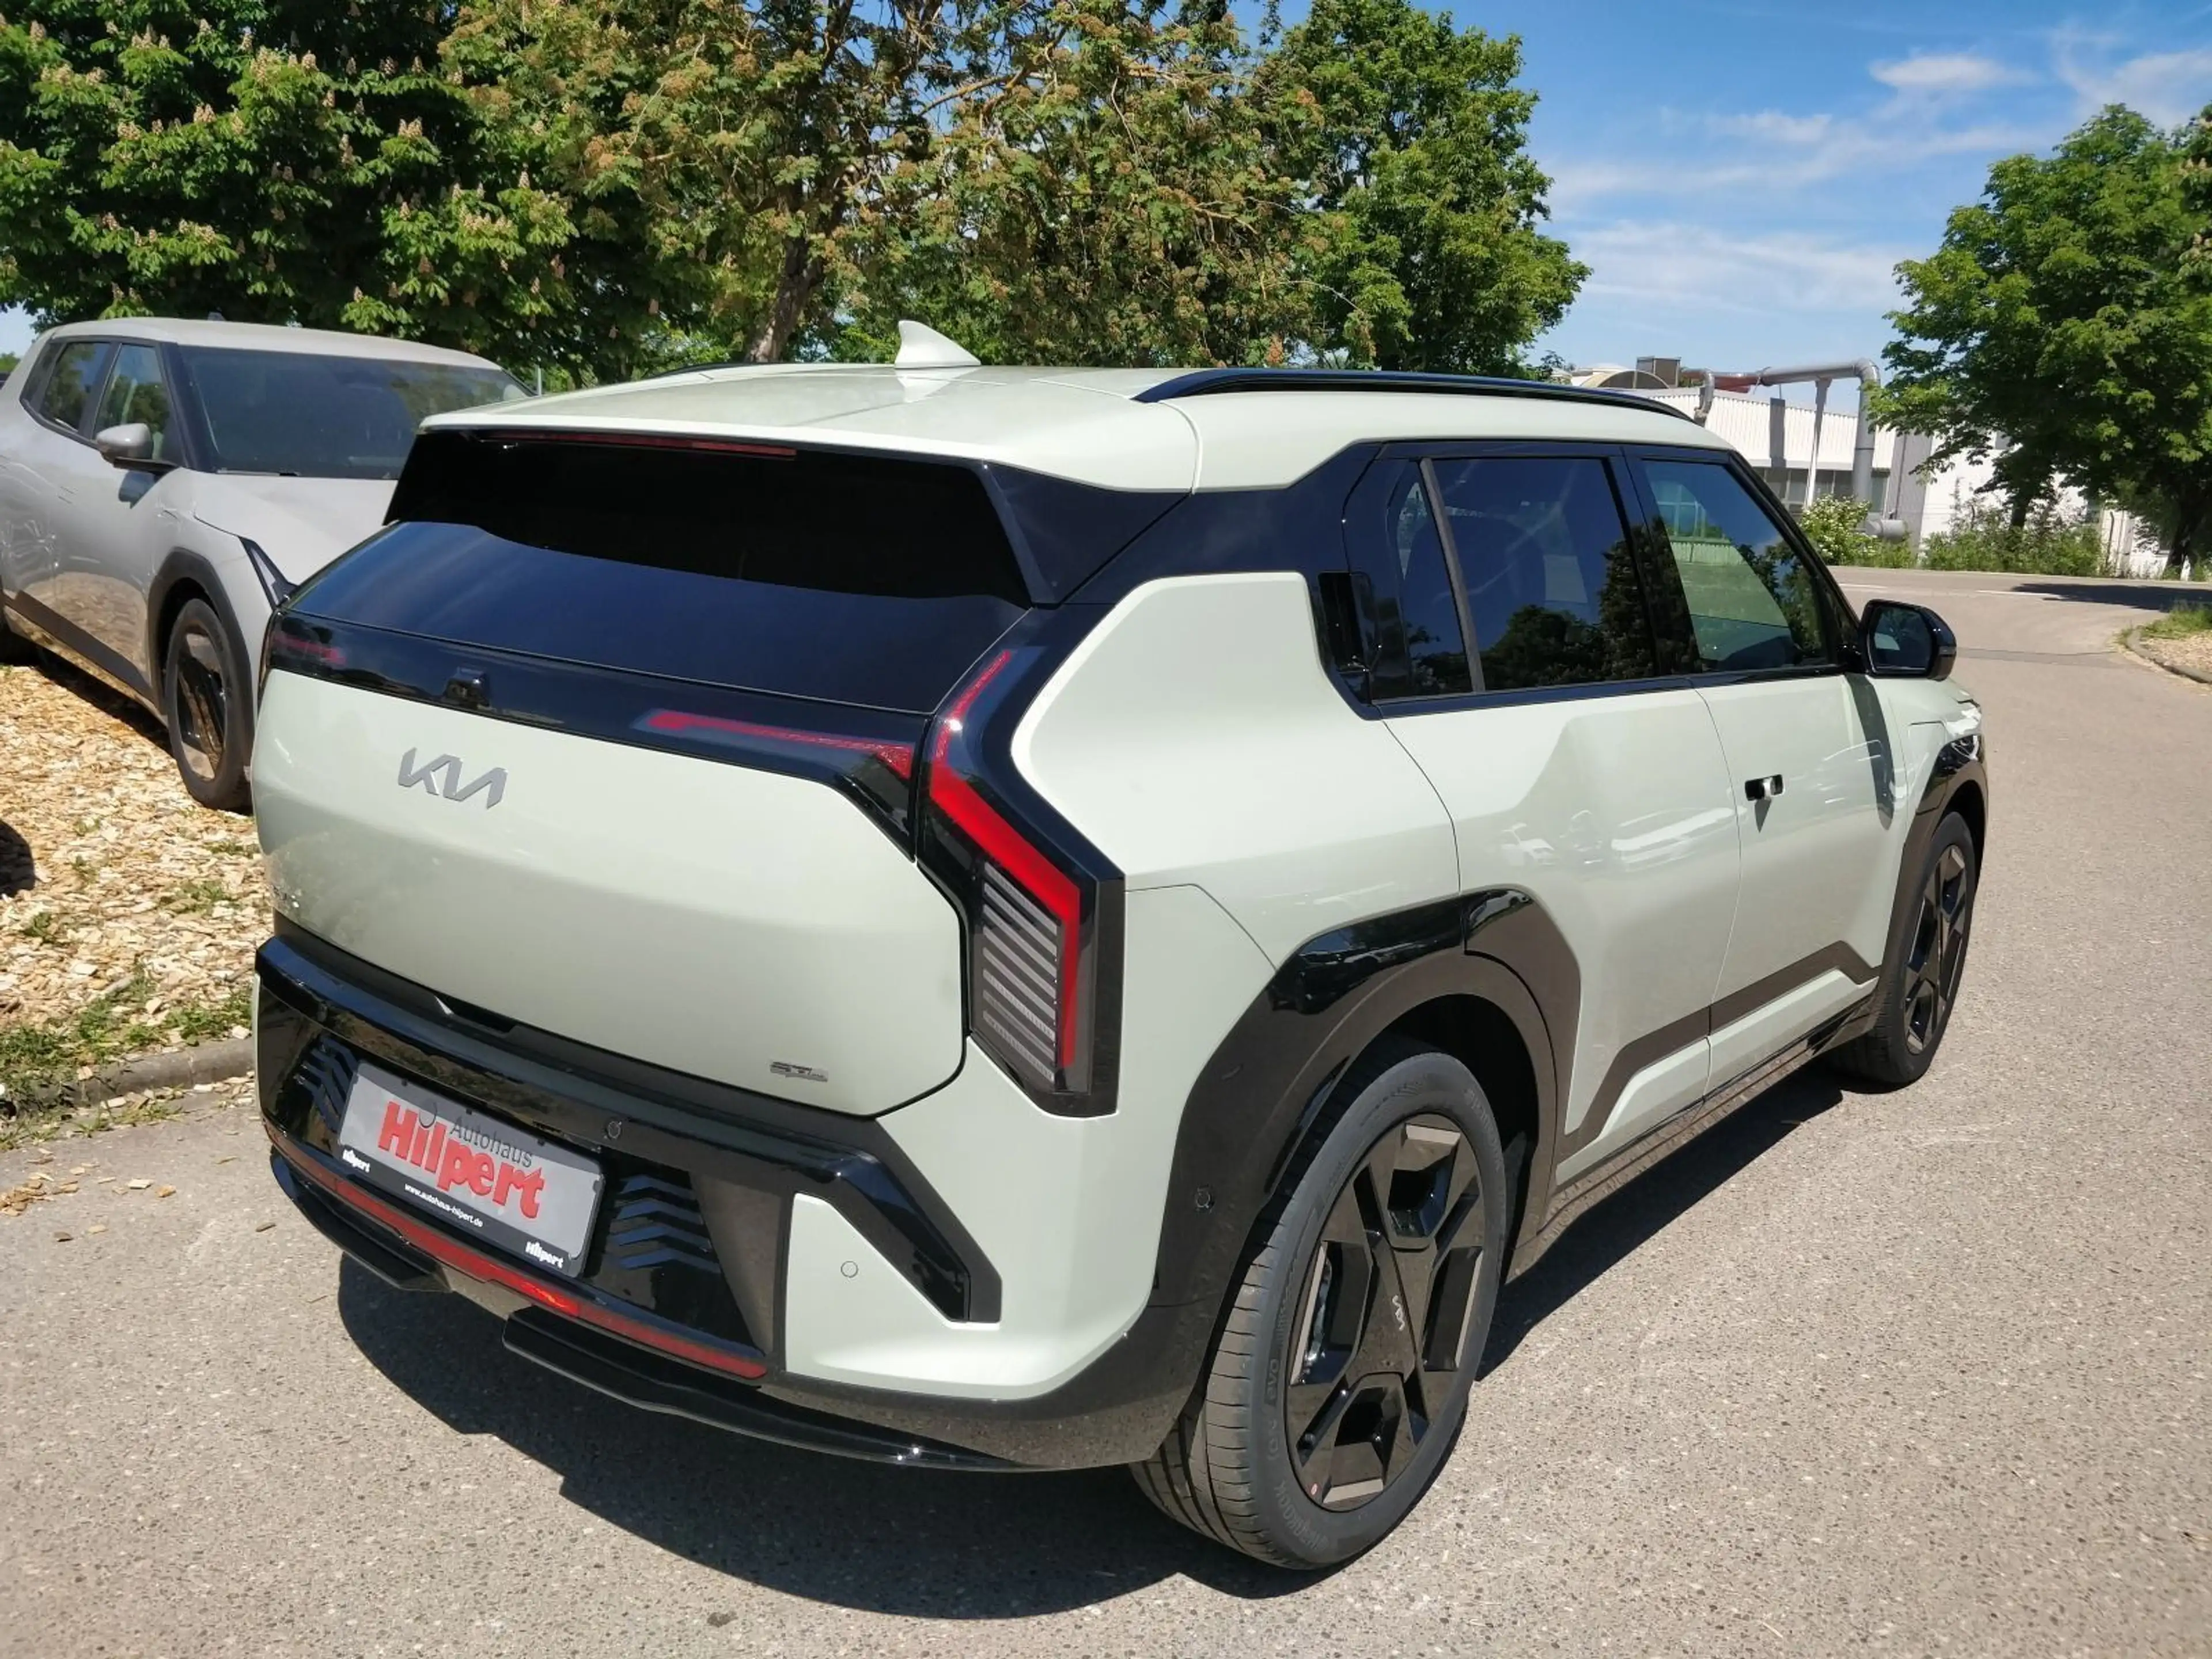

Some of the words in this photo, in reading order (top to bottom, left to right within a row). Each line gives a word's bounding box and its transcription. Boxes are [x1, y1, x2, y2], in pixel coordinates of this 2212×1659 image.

[397, 747, 507, 809] KIA
[378, 1101, 545, 1219] Hilpert
[450, 1116, 532, 1168] Autohaus
[405, 1183, 484, 1228] www.autohaus-hilpert.de
[525, 1241, 564, 1269] Hilpert
